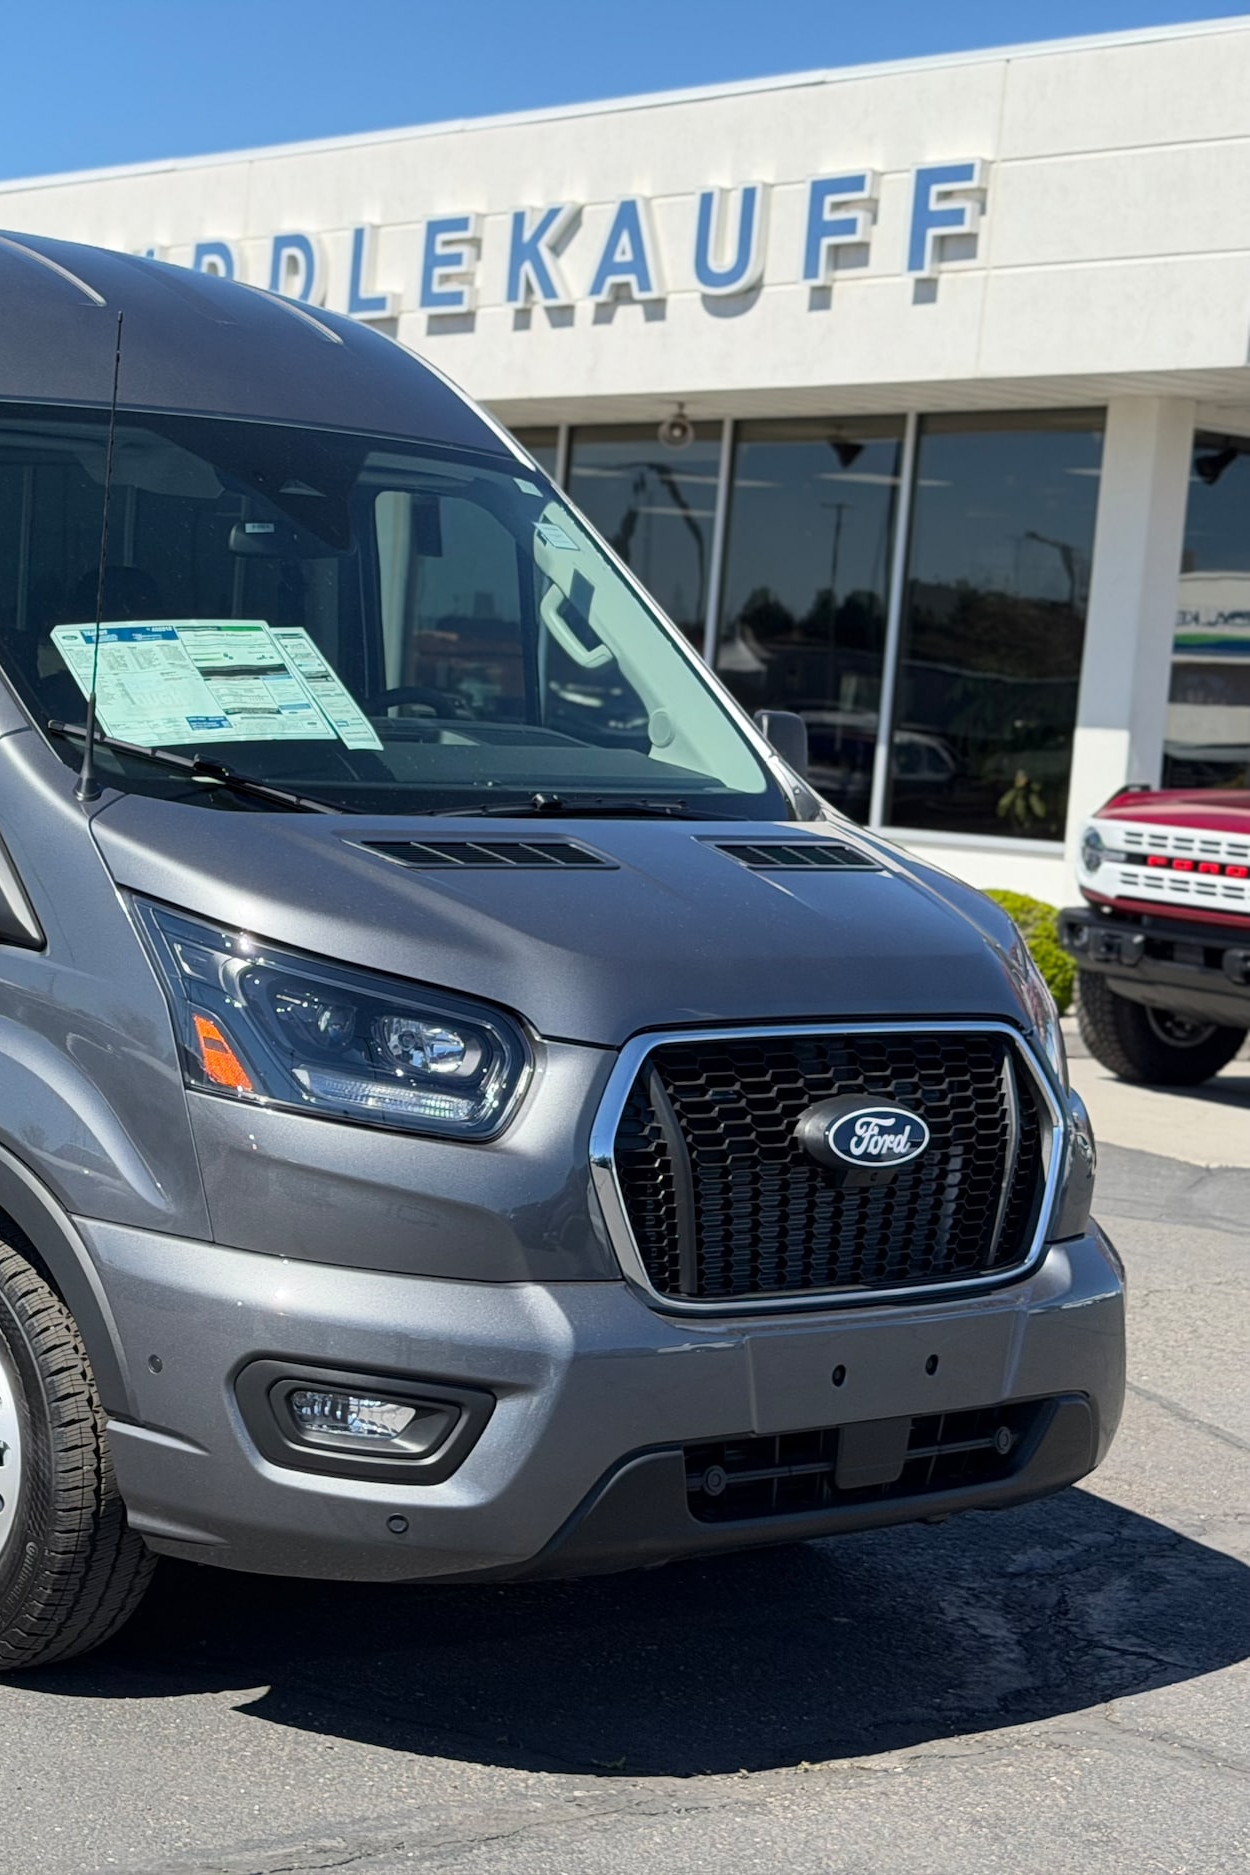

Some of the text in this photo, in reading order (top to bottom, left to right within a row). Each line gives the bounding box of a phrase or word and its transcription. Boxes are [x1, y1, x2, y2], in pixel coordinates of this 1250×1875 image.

[146, 162, 978, 315] DLEKAUFF
[1147, 854, 1249, 878] FORD
[850, 1116, 912, 1156] Ford
